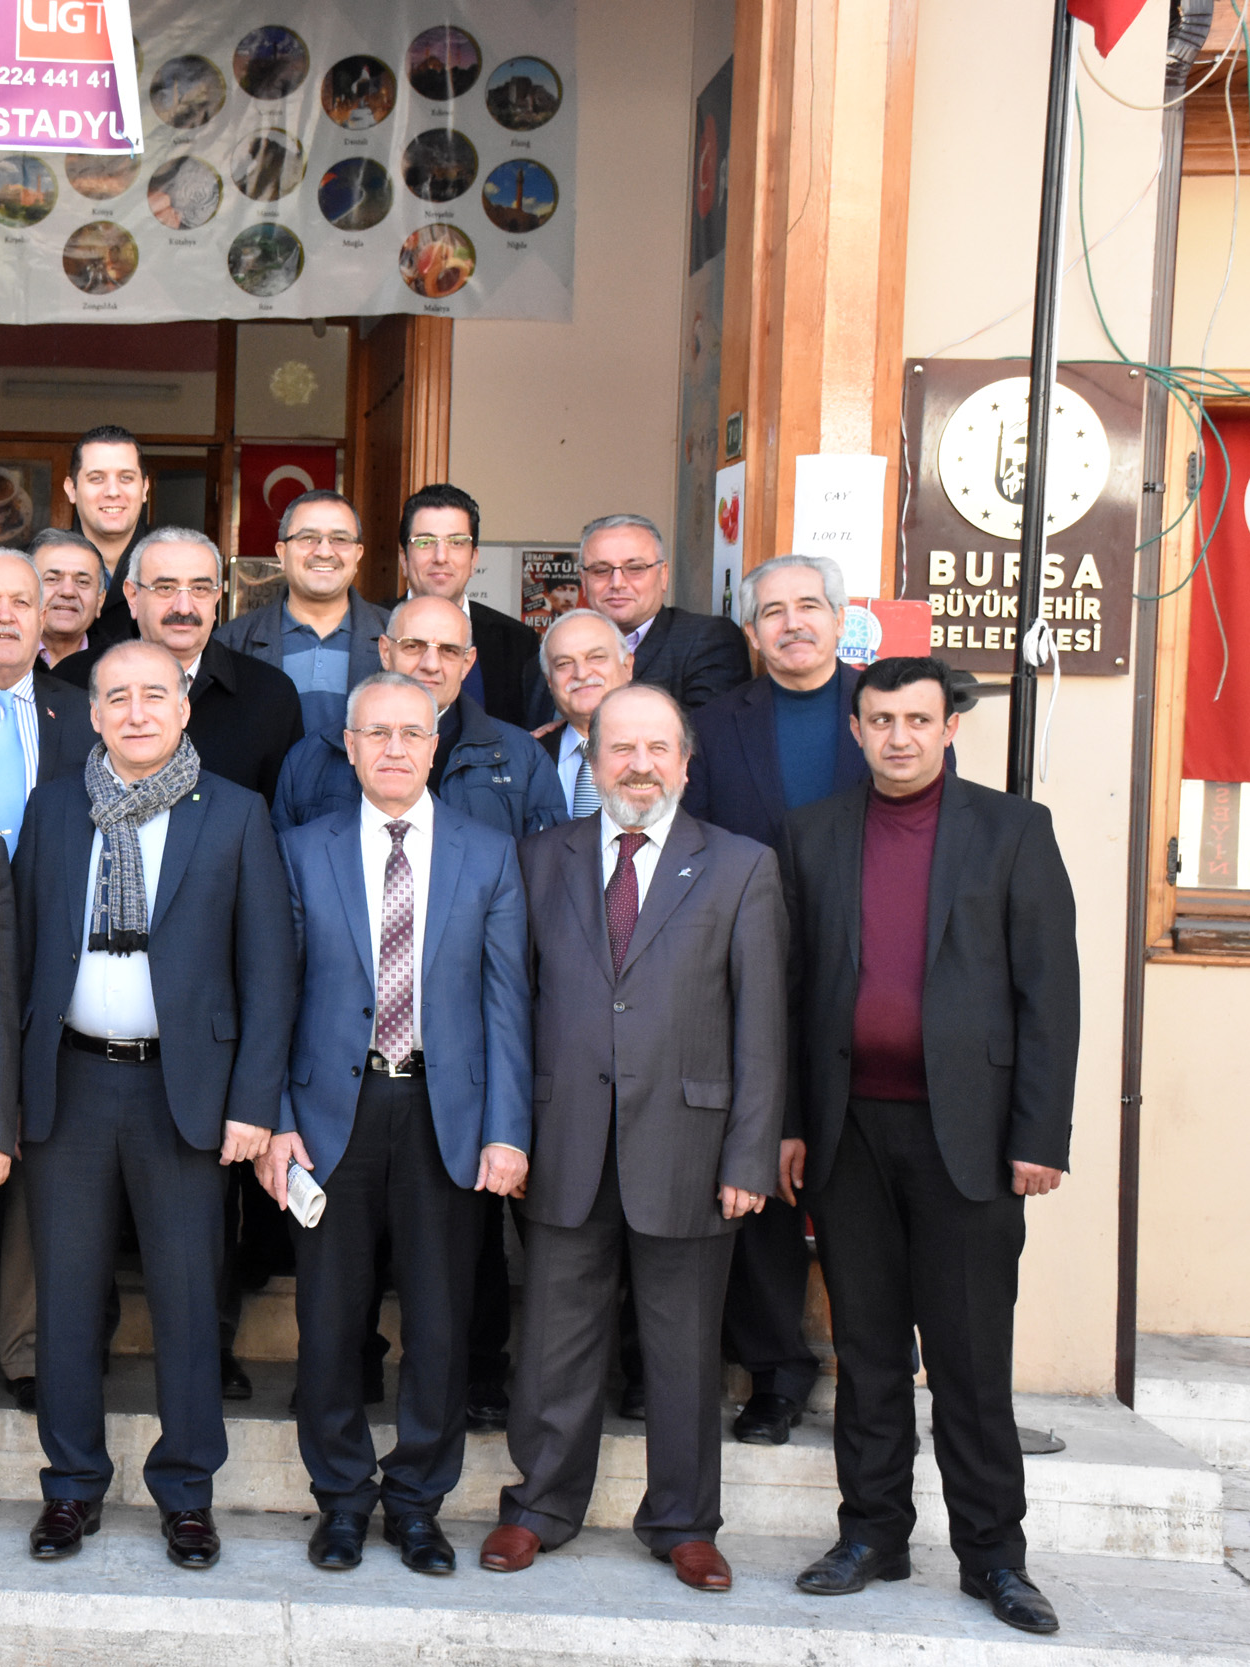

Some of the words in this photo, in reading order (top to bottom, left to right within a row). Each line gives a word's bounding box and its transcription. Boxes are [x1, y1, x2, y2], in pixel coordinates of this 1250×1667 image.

[42, 69, 78, 88] 441
[86, 70, 110, 88] 41
[840, 531, 852, 541] TL
[929, 550, 1103, 589] BURSA
[929, 588, 1101, 620] BÜYÜKEHİR
[930, 623, 1101, 652] BELEDESİ
